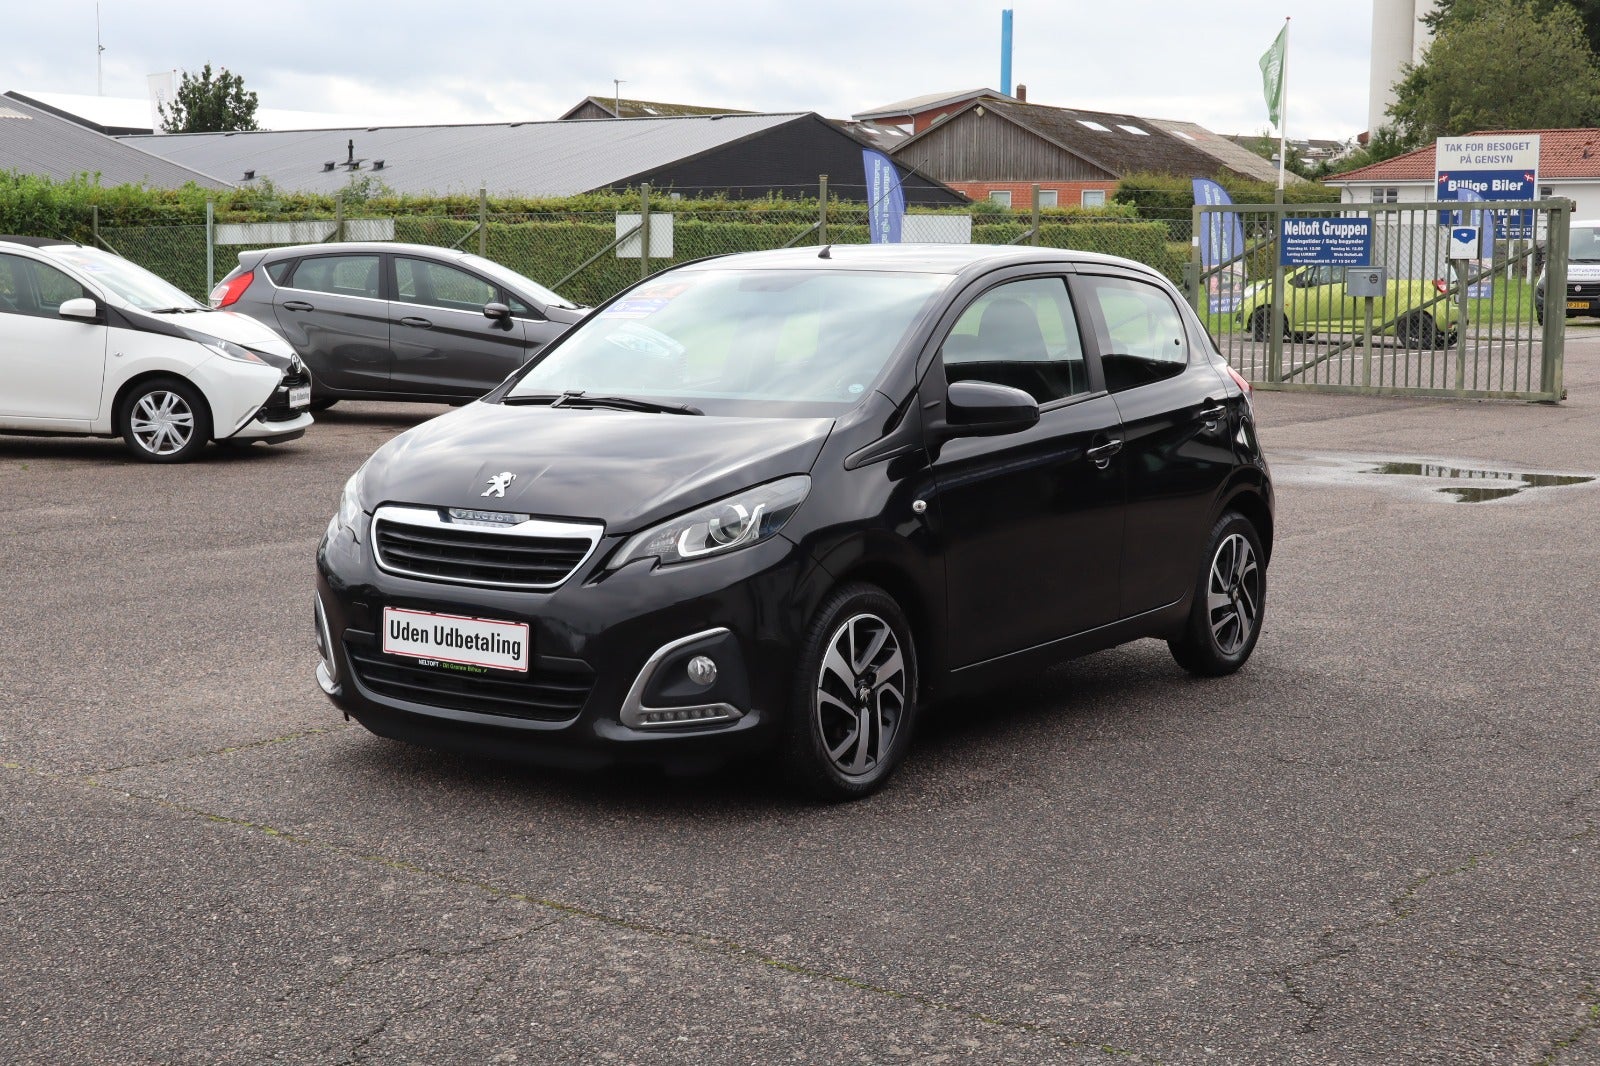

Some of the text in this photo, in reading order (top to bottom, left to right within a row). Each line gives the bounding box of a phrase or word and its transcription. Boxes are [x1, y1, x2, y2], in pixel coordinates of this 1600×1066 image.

[1445, 142, 1530, 152] TAK FOR BESØGET
[1460, 154, 1513, 164] PÅ GENSYN
[1448, 179, 1523, 193] Billige Biler
[1284, 220, 1368, 239] Neltoft Gruppen
[460, 510, 512, 522] PEUGEOT
[390, 620, 521, 661] Uden Udbetaling
[418, 659, 439, 668] NELTOFT
